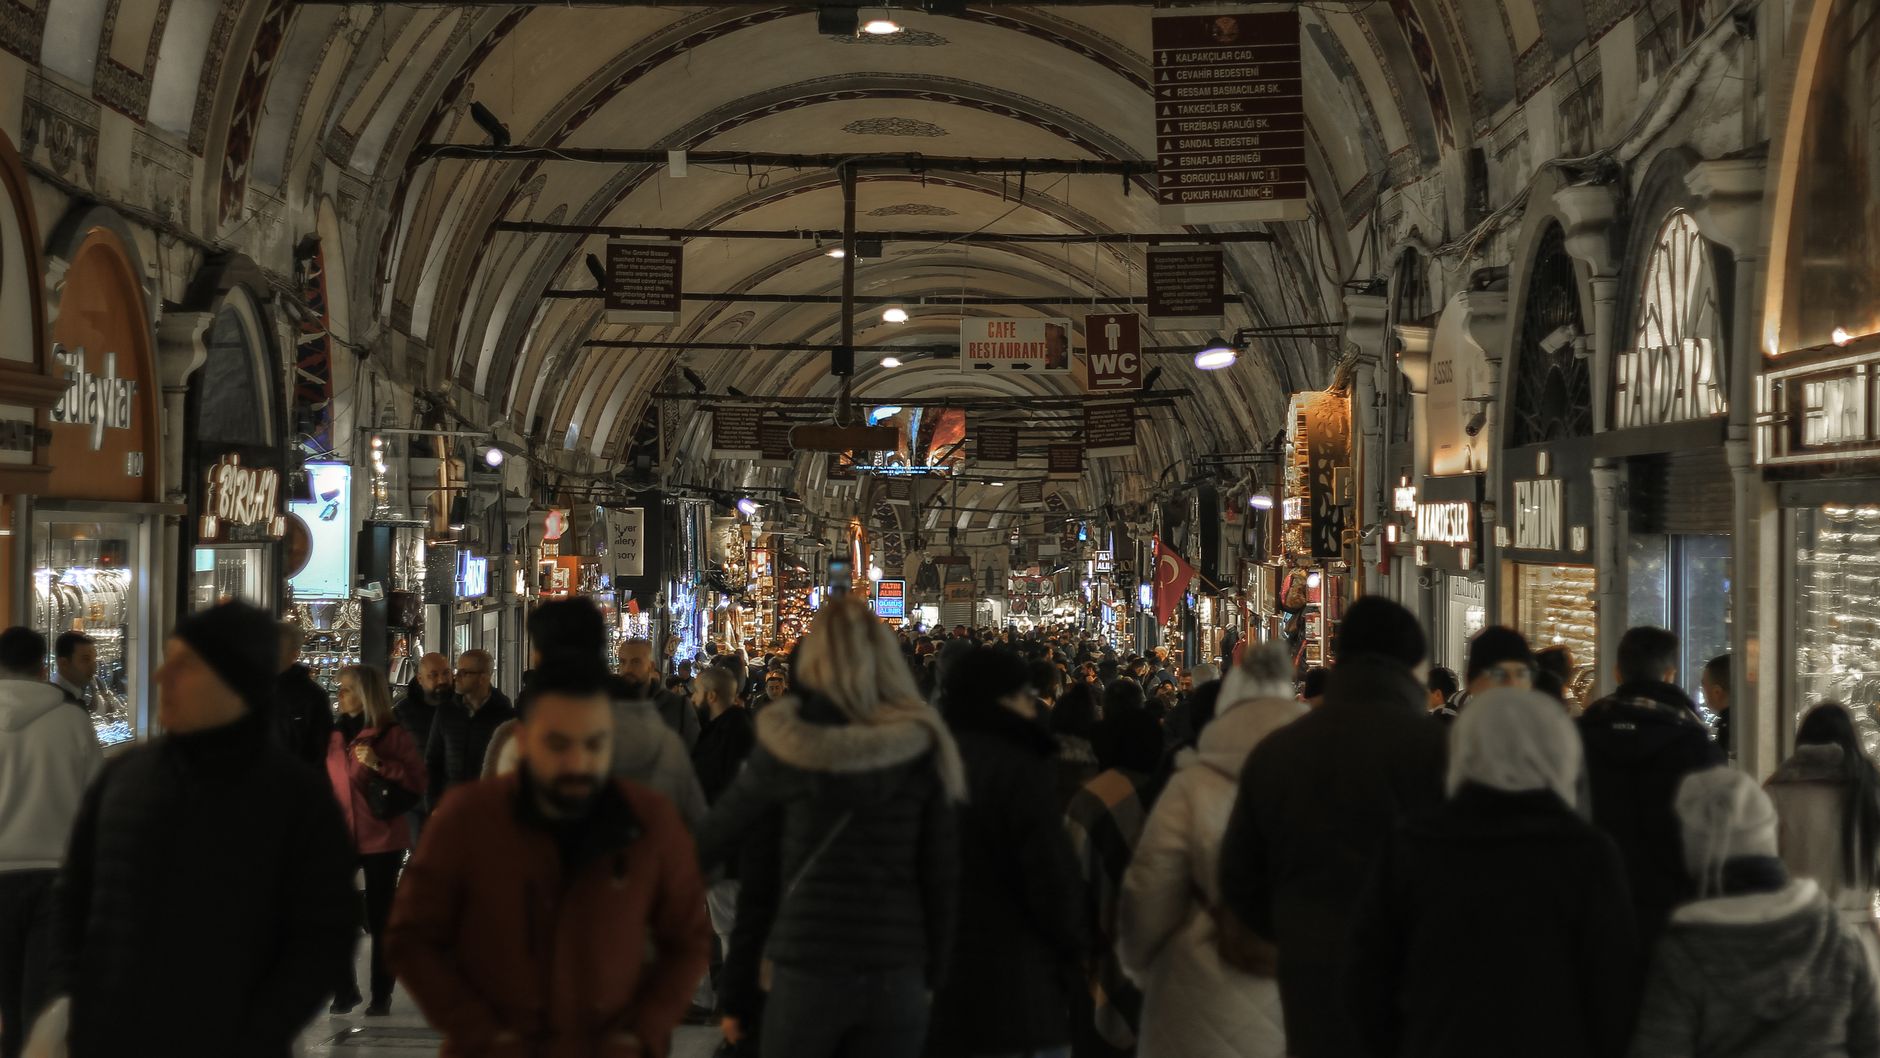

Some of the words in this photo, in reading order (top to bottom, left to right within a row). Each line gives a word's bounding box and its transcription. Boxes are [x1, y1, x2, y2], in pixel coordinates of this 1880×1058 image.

[1175, 51, 1233, 63] KALPAKÇILAR
[1234, 50, 1254, 60] CAD.
[1176, 67, 1212, 80] CEVAHİR
[1214, 66, 1259, 78] BEDESTENİ
[1177, 86, 1211, 97] RESSAM
[1212, 85, 1265, 96] BASMACILAR
[1266, 84, 1280, 94] SK.
[1177, 102, 1229, 114] TAKKECİLER
[1230, 103, 1244, 112] SK.
[1178, 119, 1221, 132] TERZİBAŞI
[1222, 118, 1255, 130] ARALIĞI
[1256, 119, 1270, 128] SK.
[1179, 139, 1212, 149] SANDAL
[1214, 135, 1260, 147] BEDESTENİ
[1180, 156, 1223, 166] ESNAFLAR
[1224, 152, 1261, 164] DERNEĞİ
[1180, 173, 1226, 185] SORGUÇLU
[1227, 172, 1244, 182] HAN
[1250, 170, 1265, 180] WC
[1181, 190, 1210, 202] ÇUKUR
[987, 321, 1016, 338] CAFE
[969, 342, 1045, 359] RESTAURANT
[1091, 353, 1138, 375] WC
[1433, 360, 1453, 385] ASSOS
